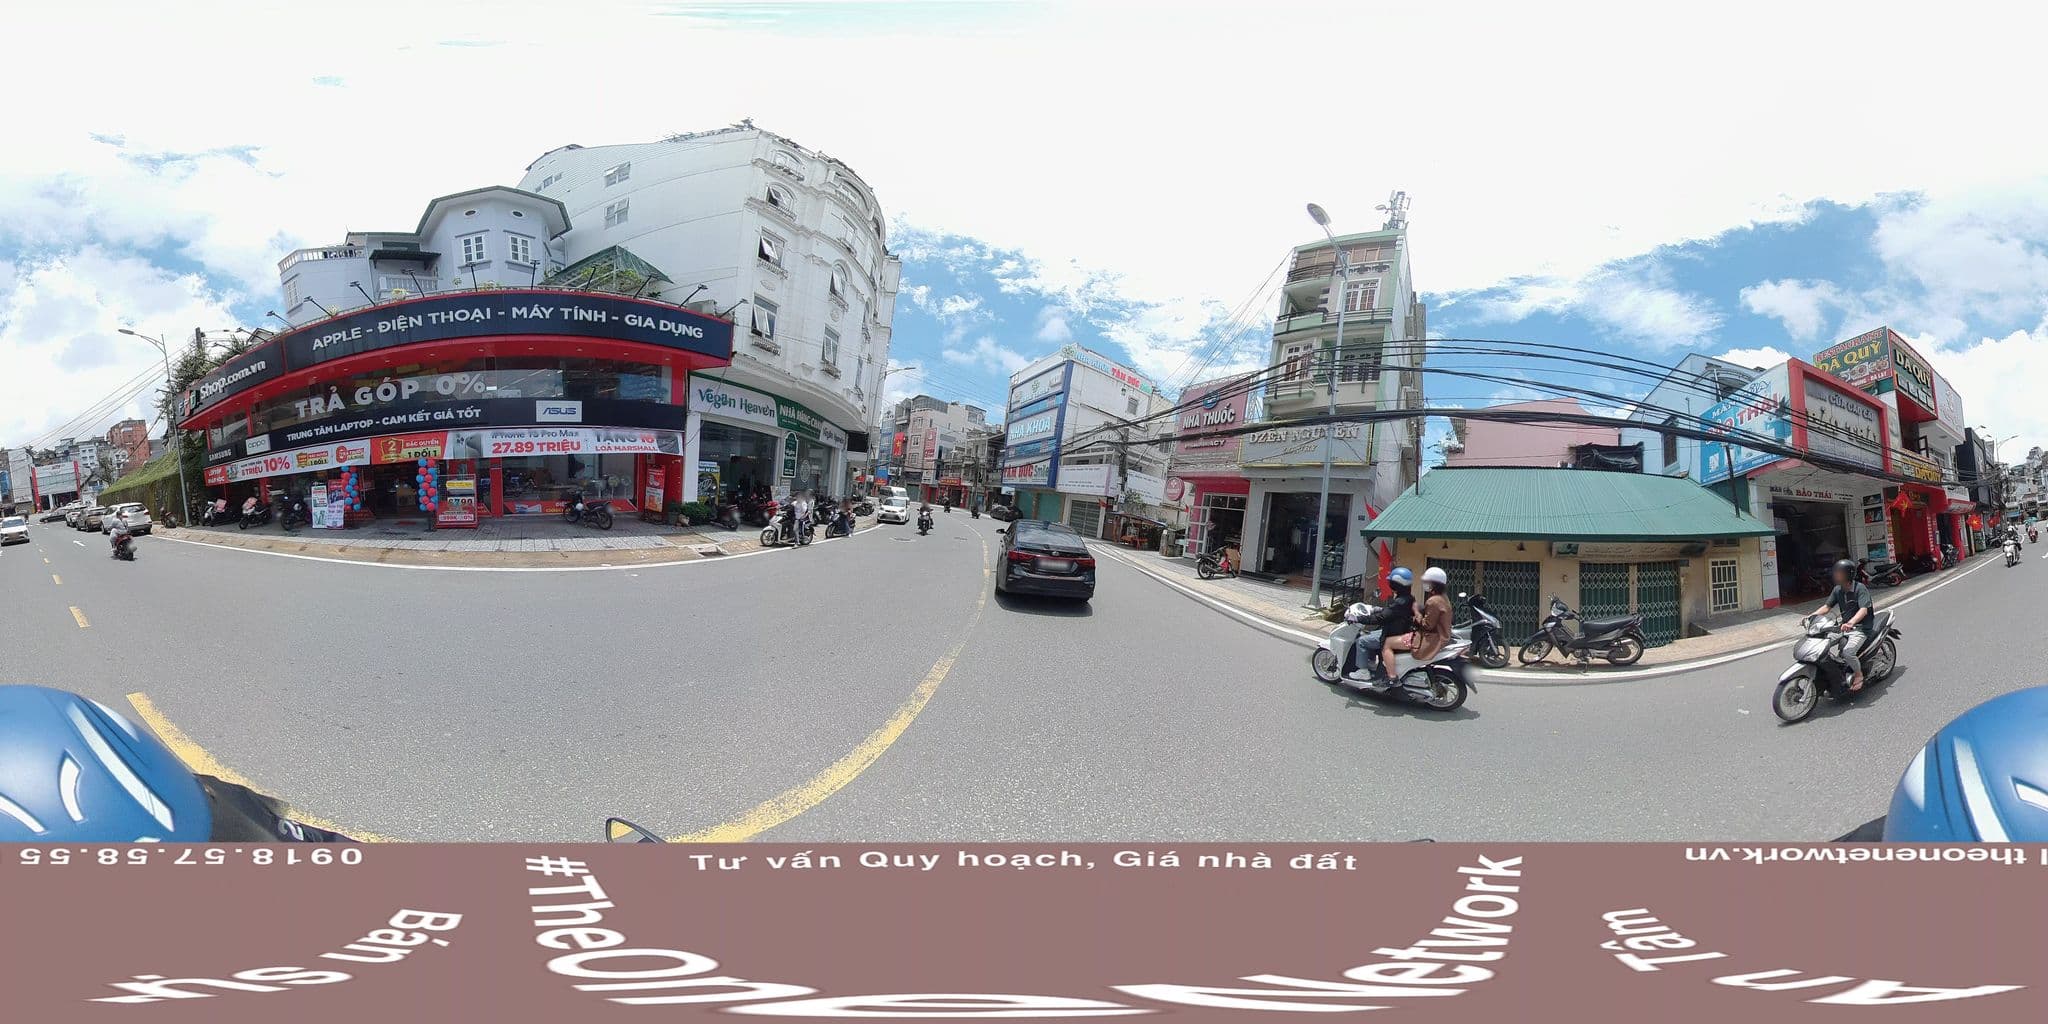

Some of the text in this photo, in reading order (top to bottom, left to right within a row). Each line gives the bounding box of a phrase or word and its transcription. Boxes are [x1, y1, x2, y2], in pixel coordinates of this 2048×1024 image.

[312, 303, 704, 351] APPLE ĐIỆN THOẠI MÁY TÍNH GIA DỤNG
[295, 374, 485, 418] TRẢ GÓP 0%
[698, 388, 736, 410] Vegan
[542, 407, 577, 415] ASUS
[779, 404, 796, 420] NHÀ
[1182, 402, 1236, 430] NHÀ THUỐC
[286, 405, 482, 441] TRUNG TÂM LAPTOP CAM KẾT GIÁ TỐT
[208, 449, 232, 462] SAMSUNG
[492, 438, 581, 455] 27.89 TRIỆU
[263, 455, 290, 473] 10%
